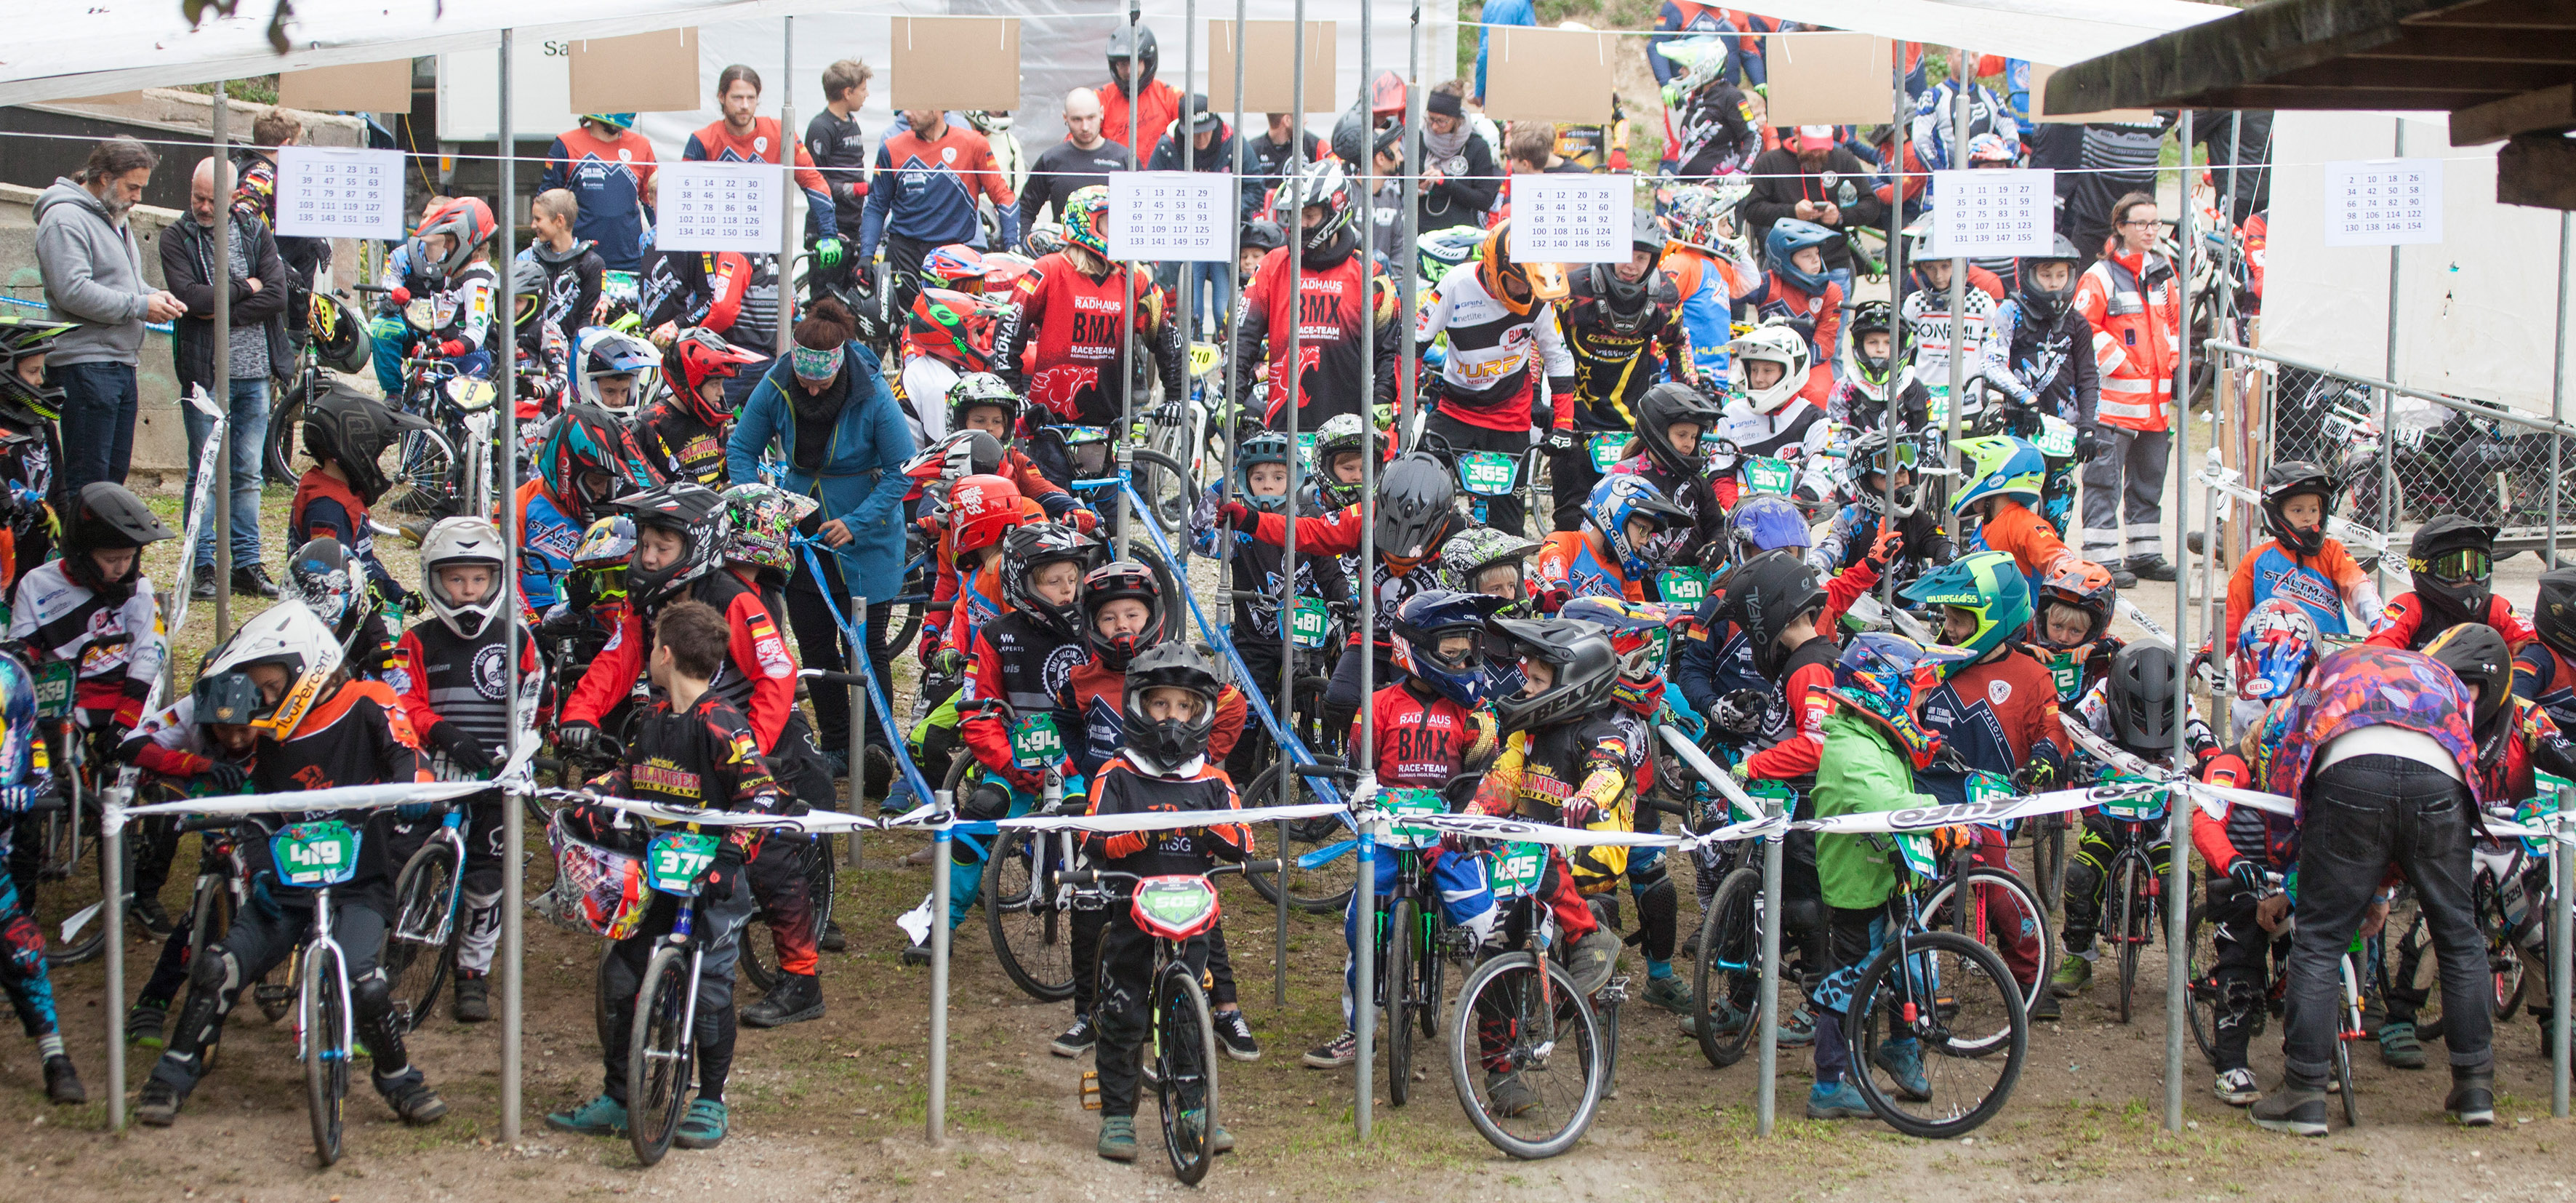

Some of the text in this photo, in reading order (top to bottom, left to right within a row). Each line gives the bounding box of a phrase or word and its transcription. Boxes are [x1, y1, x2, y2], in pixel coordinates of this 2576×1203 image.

[305, 164, 378, 175] 7 15 23 31
[302, 176, 379, 187] 39 47 55 63
[2349, 174, 2419, 184] 2 10 18 26
[302, 188, 378, 199] 71 79 87 95
[1136, 188, 1141, 196] 5
[1197, 189, 1208, 197] 29
[1599, 191, 1609, 199] 28
[2388, 186, 2398, 194] 50
[299, 201, 380, 211] 103 111 119 127
[1133, 201, 1143, 209] 37
[1197, 201, 1207, 209] 61
[1598, 203, 1609, 211] 60
[2346, 200, 2356, 208] 66
[2388, 199, 2398, 207] 82
[2409, 198, 2420, 206] 90
[299, 213, 314, 221] 135
[343, 215, 358, 223] 151
[365, 215, 380, 224] 159
[1154, 213, 1164, 221] 77
[1175, 213, 1186, 221] 85
[1534, 215, 1544, 223] 68
[1556, 215, 1565, 223] 76
[1598, 215, 1608, 223] 92
[2346, 209, 2421, 220] 98 106 114 122
[1152, 225, 1166, 233] 109
[1173, 225, 1188, 233] 117
[1533, 228, 1547, 236] 100
[2346, 224, 2359, 232] 130
[2386, 223, 2401, 231] 146
[1130, 237, 1144, 245] 133
[1195, 238, 1209, 246] 157
[1075, 298, 1121, 311] RADHAUS
[1072, 311, 1119, 345] BMX
[997, 301, 1022, 370] RADHAUS
[1071, 345, 1116, 356] RACE-TEAM
[1469, 464, 1509, 482] 365
[1753, 469, 1787, 489] 367
[1989, 476, 2003, 488] BELL
[958, 486, 984, 500] URGE
[960, 495, 983, 508] PRO
[966, 505, 986, 516] CO.
[1594, 503, 1632, 562] NITRO CIRCUS
[1669, 580, 1704, 599] 491
[2263, 569, 2341, 612] STALTMAYR
[1745, 585, 1768, 646] ONEAL
[1293, 611, 1322, 633] 481
[2249, 682, 2269, 692] BELL
[1399, 710, 1451, 726] RADAUS
[1982, 708, 2004, 743] MALOJA
[1018, 730, 1061, 752] 494
[1397, 729, 1451, 762] BMX
[1397, 764, 1448, 774] RACE-TEAM
[631, 764, 702, 789] ERLANGEN
[753, 796, 776, 809] VANS
[290, 839, 341, 866] 419
[1494, 855, 1538, 882] 495
[1154, 895, 1200, 910] 505
[2503, 885, 2523, 911] 329
